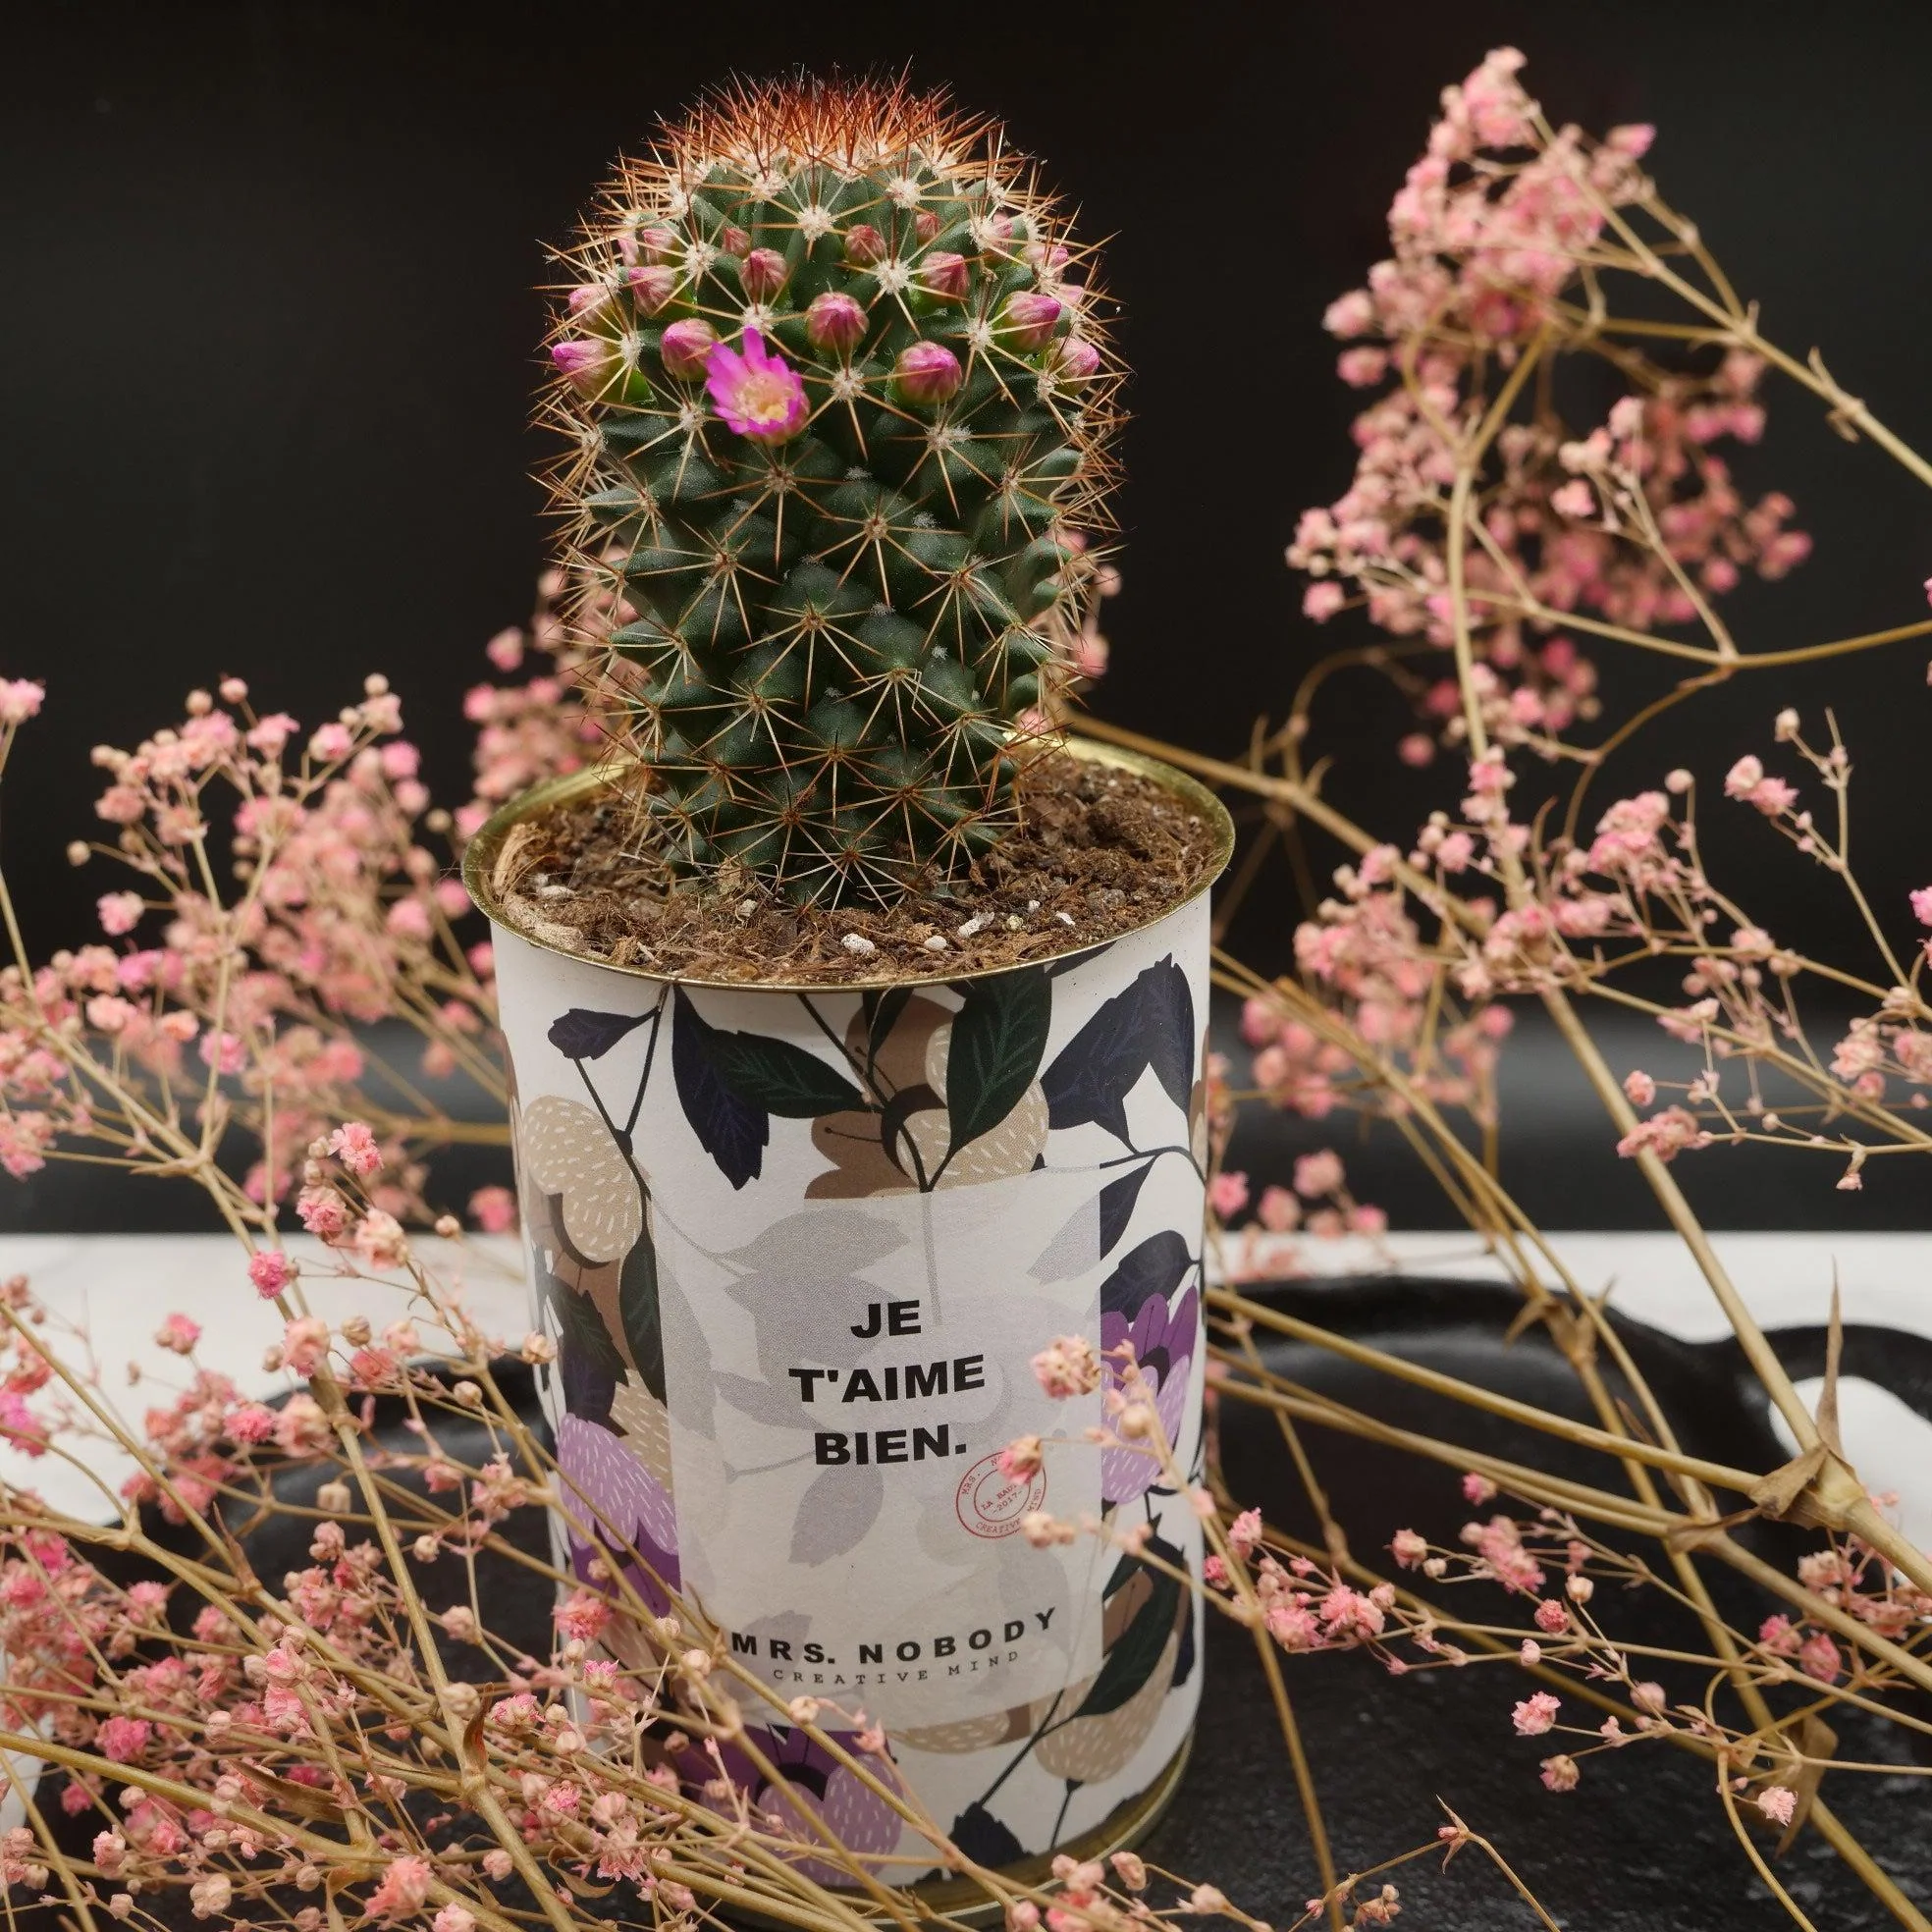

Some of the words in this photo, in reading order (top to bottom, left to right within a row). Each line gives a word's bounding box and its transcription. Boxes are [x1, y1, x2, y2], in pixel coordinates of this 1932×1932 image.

[850, 1300, 921, 1338] JE
[788, 1355, 985, 1402] T'AIME
[814, 1424, 967, 1465] BIEN.
[731, 1633, 835, 1664] MRS.
[859, 1607, 1056, 1664] NOBODY
[774, 1669, 928, 1686] CREATIVE
[947, 1651, 1019, 1676] MIND
